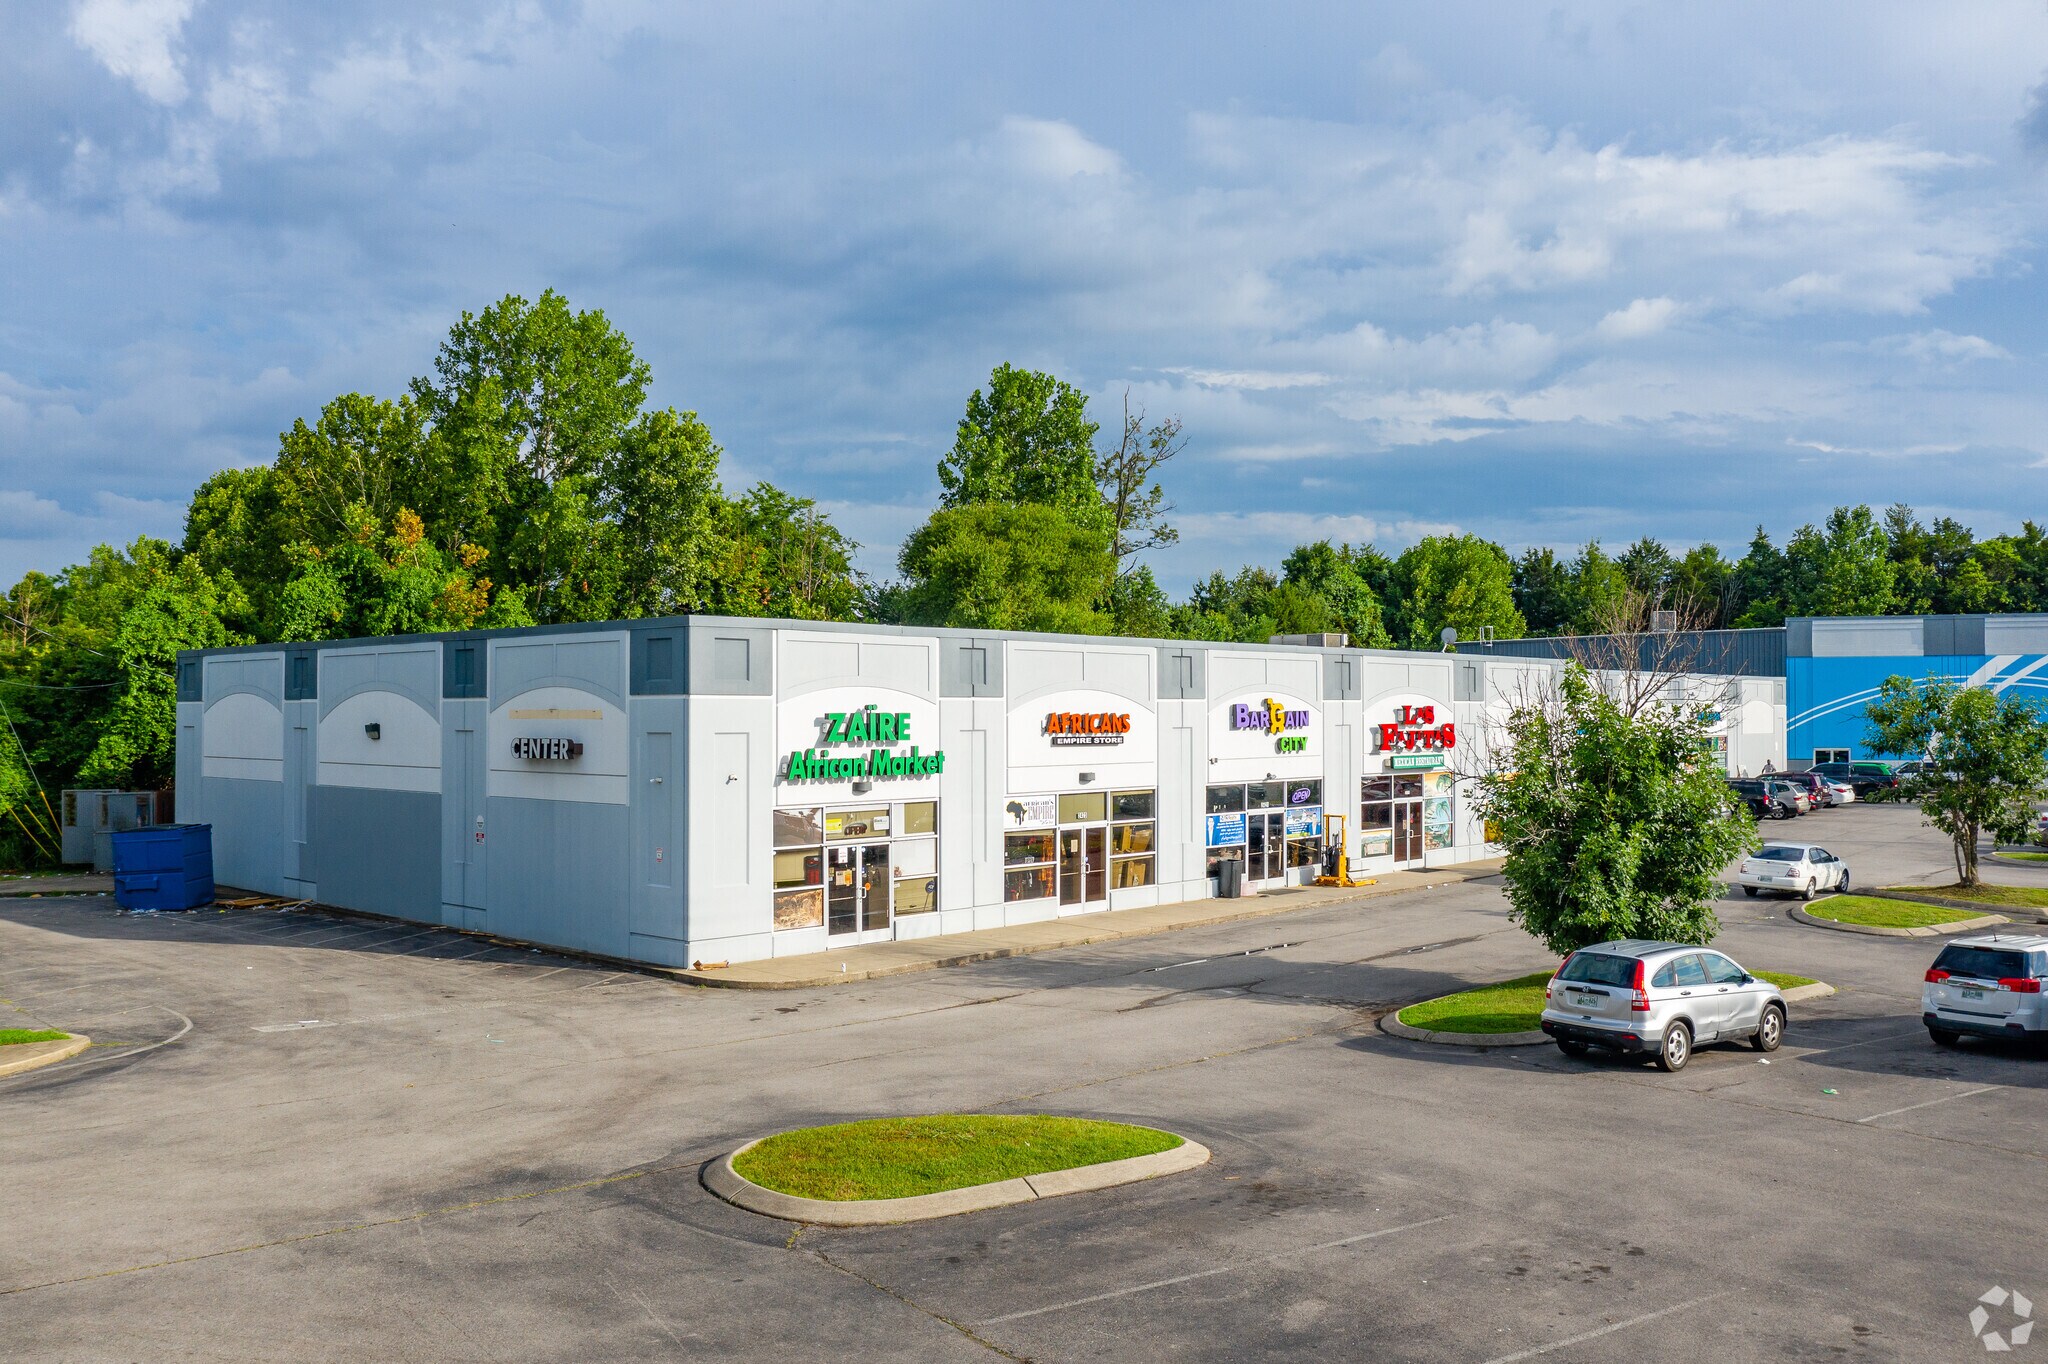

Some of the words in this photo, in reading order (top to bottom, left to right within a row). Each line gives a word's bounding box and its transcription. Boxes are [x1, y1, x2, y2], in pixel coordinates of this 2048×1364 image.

[825, 704, 911, 742] ZAÏRE
[1048, 711, 1131, 735] AFRICANS
[1402, 705, 1435, 725] LAS
[1057, 737, 1092, 745] EMPIRE
[1093, 736, 1124, 744] STORE
[1279, 737, 1309, 752] CITY
[1379, 723, 1456, 750] FAJITAS
[511, 737, 569, 760] CENTER
[787, 748, 866, 779] African
[869, 746, 945, 777] Market
[1293, 789, 1309, 802] OPEN
